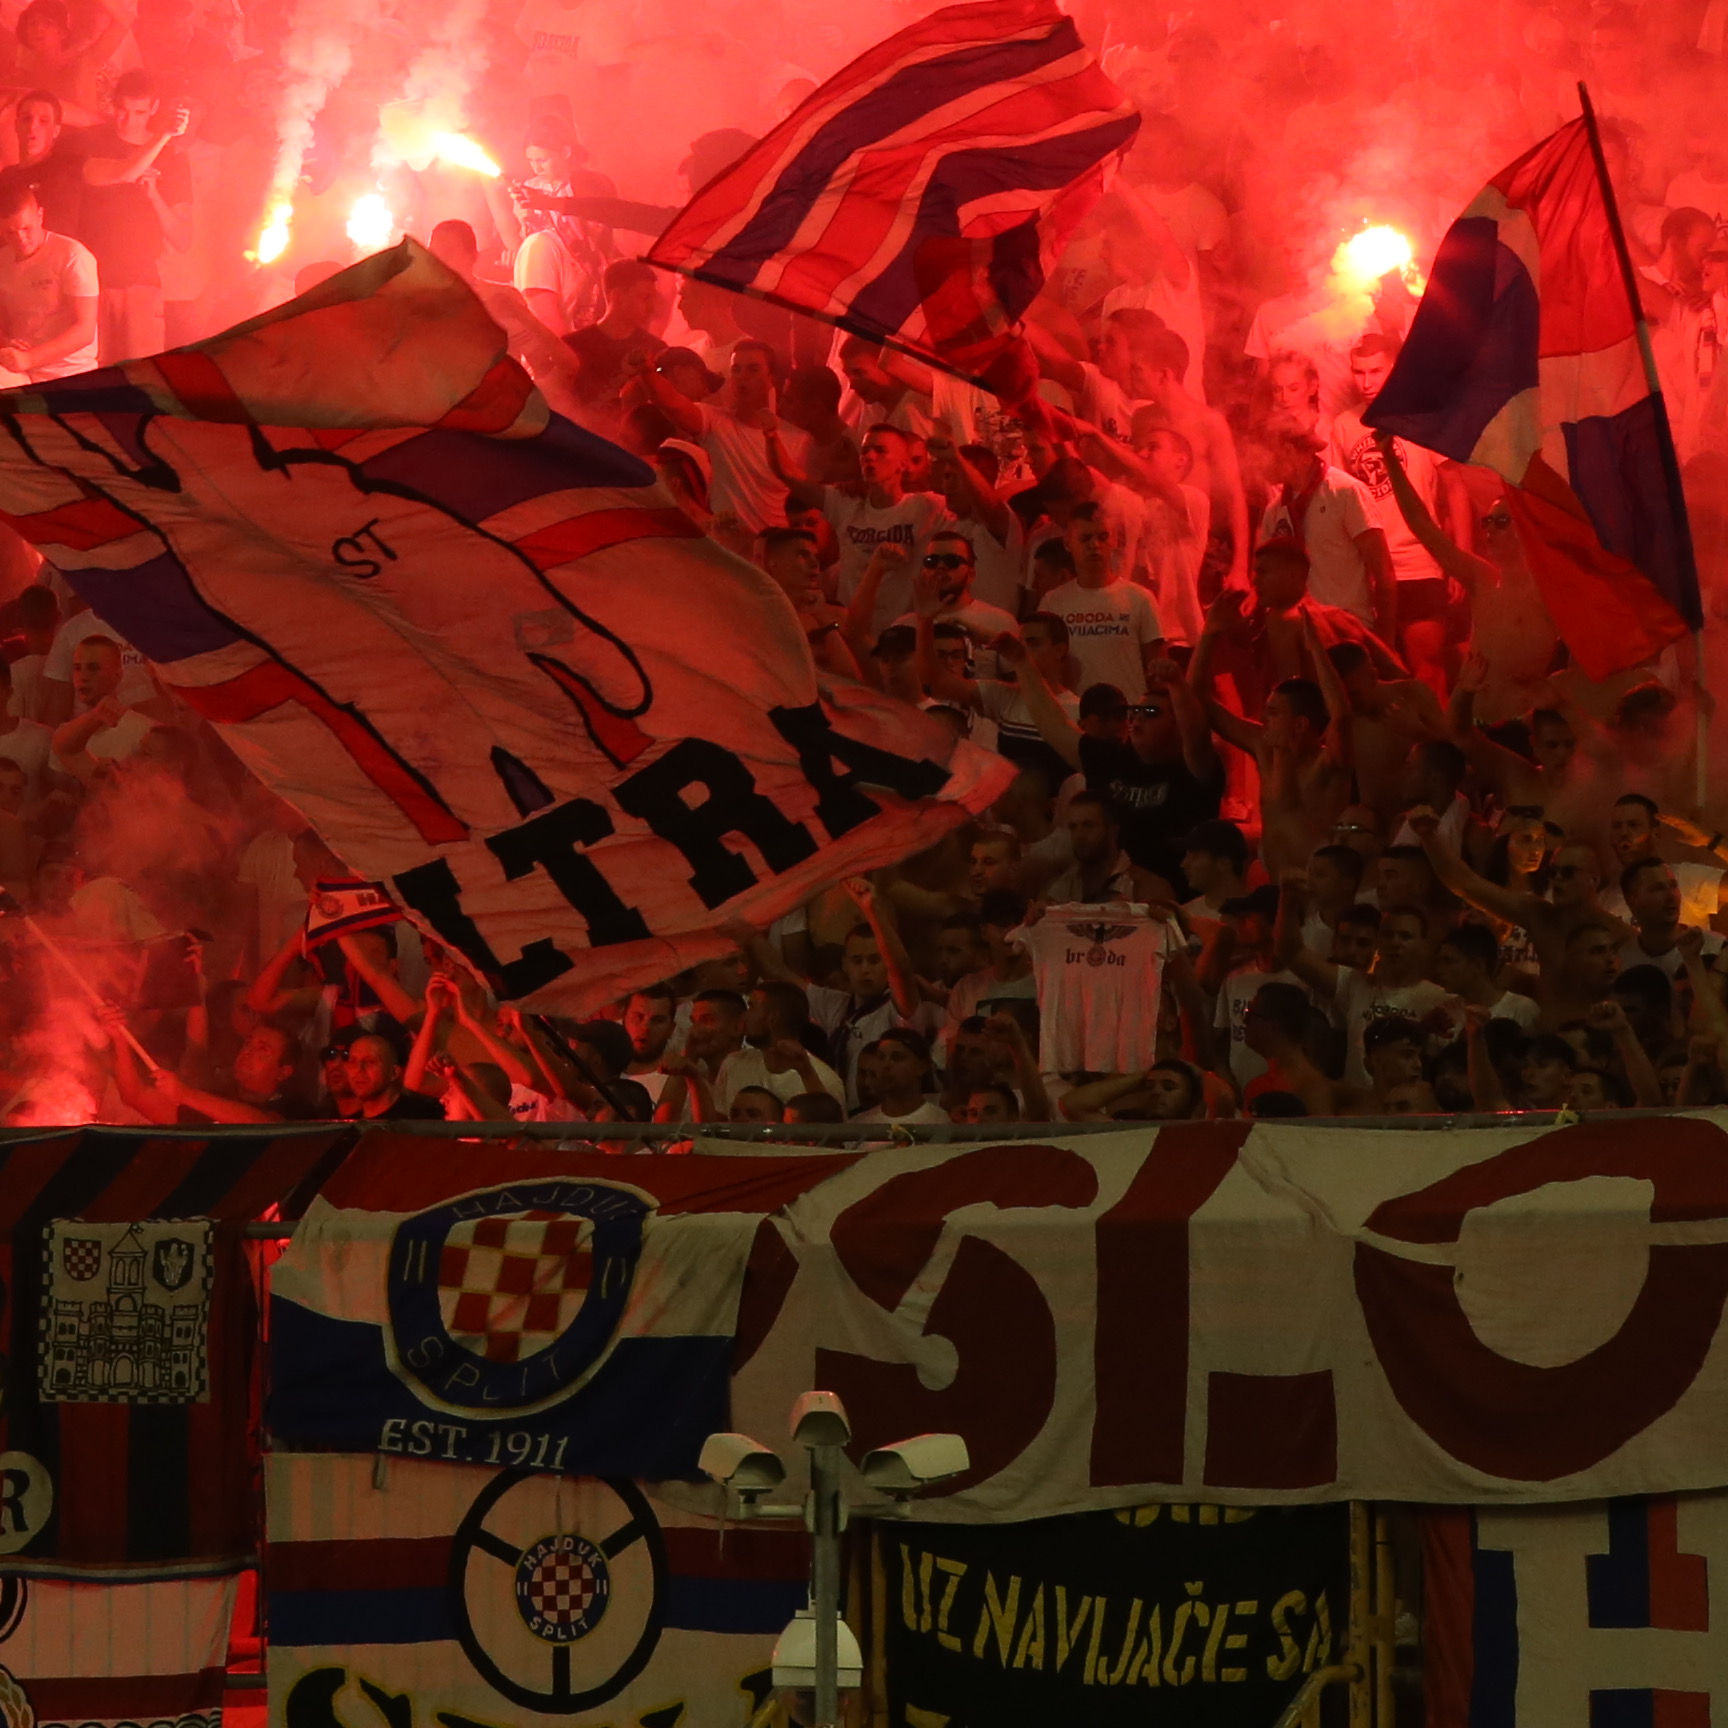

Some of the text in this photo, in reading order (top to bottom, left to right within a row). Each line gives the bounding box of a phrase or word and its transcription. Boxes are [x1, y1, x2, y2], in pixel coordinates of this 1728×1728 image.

[332, 517, 398, 579] ST
[846, 524, 915, 546] TORCIDA
[453, 1185, 638, 1221] HAJDU
[408, 1336, 560, 1401] SPLIT
[378, 1417, 570, 1471] EST. 1911
[523, 1537, 603, 1571] HAJDUK
[529, 1615, 589, 1640] SPLIT
[899, 1542, 1332, 1687] UZ NAVIJAČE SA
